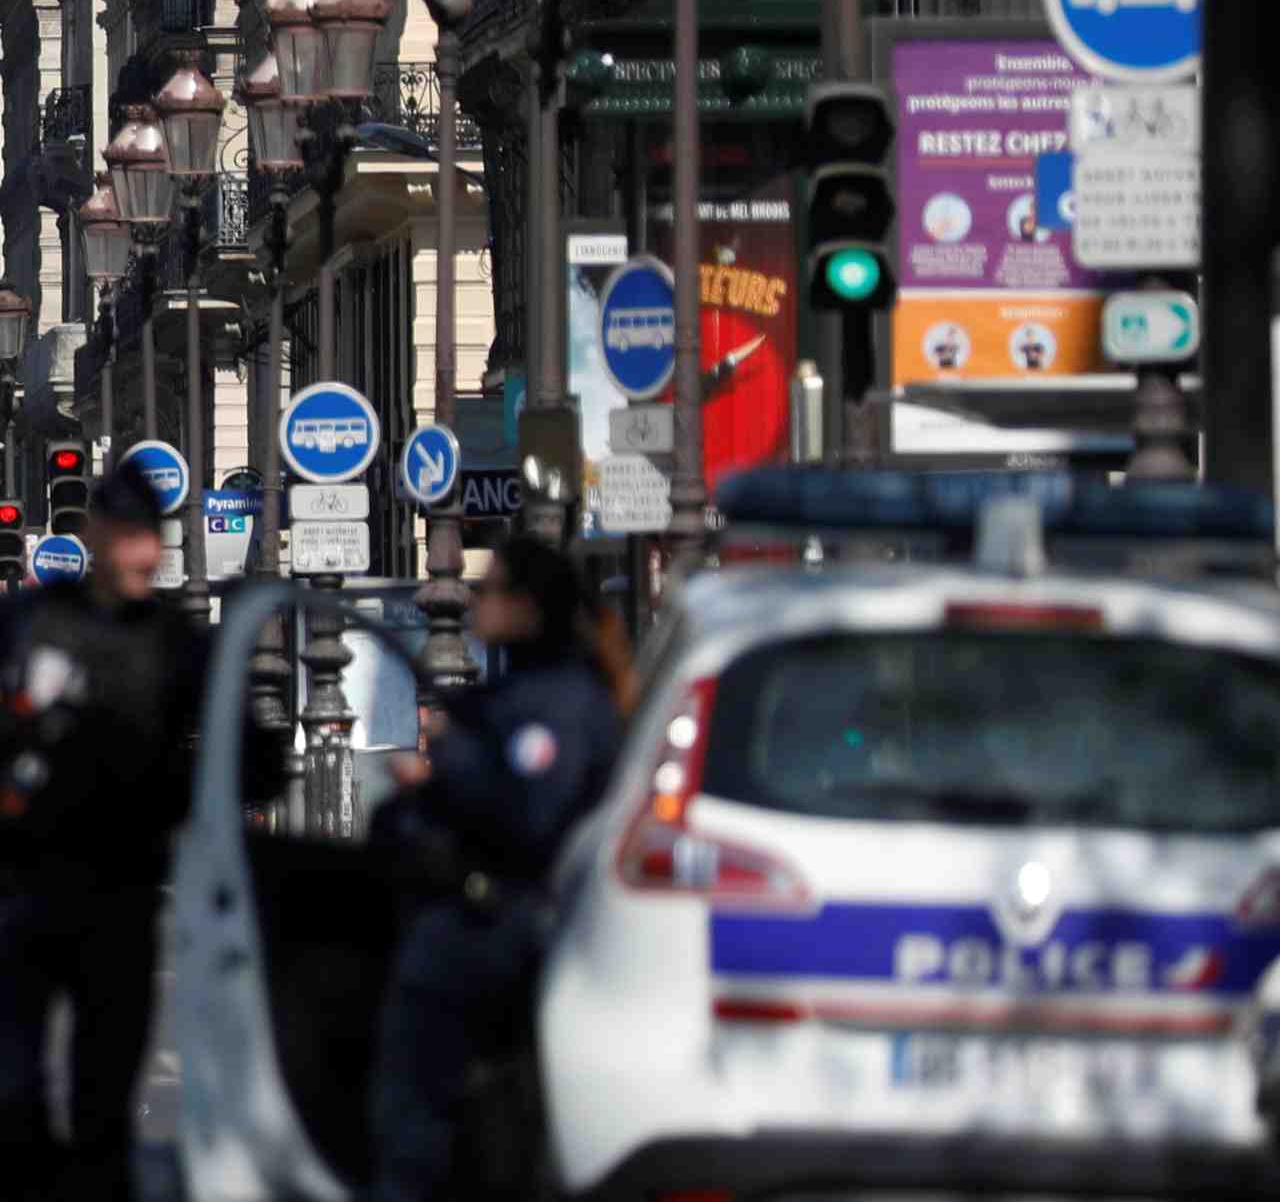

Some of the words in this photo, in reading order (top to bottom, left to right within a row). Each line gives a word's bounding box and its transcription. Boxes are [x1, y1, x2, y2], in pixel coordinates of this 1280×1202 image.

[919, 130, 1003, 154] RESTEZ
[210, 517, 243, 532] CIC
[894, 933, 1153, 991] POLICE
